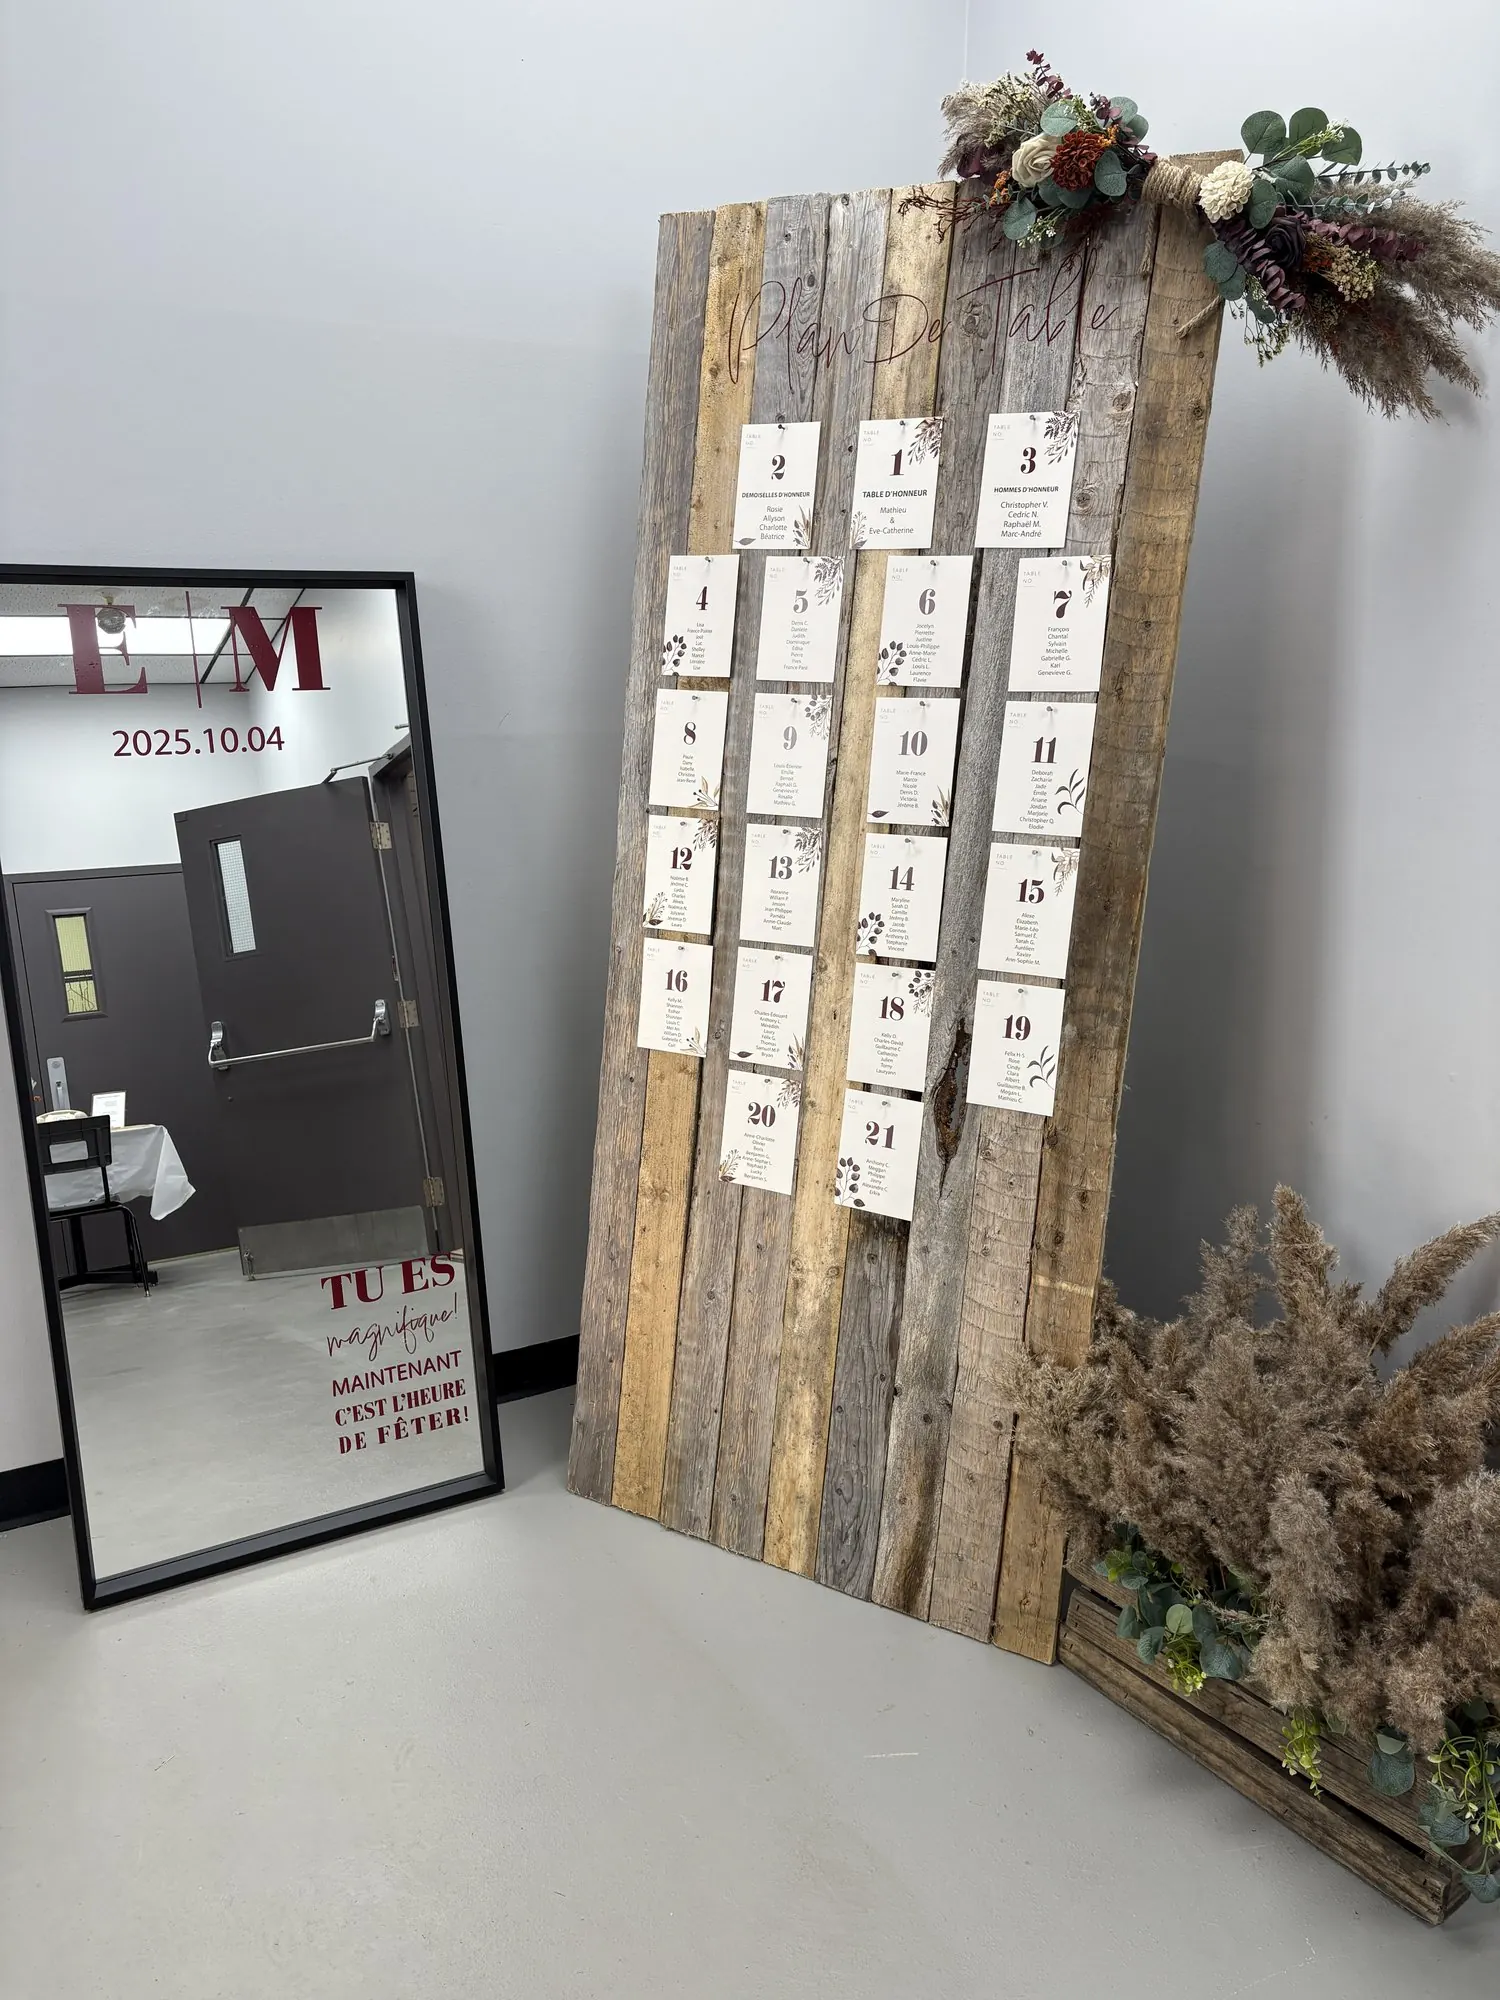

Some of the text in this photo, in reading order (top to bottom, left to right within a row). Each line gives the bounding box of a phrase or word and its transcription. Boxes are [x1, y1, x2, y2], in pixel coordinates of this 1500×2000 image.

[728, 249, 1119, 395] Plan De Table
[771, 454, 786, 480] 2
[889, 449, 904, 476] 1
[1020, 447, 1036, 474] 3
[884, 489, 928, 497] D'HONNEUR
[1000, 502, 1041, 510] Christopher
[762, 515, 786, 523] Allyson
[880, 506, 907, 514] Mathieu
[1003, 521, 1032, 529] Raphaël
[696, 586, 708, 611] 4
[793, 589, 808, 613] 5
[919, 588, 936, 615] 6
[1053, 590, 1072, 618] 7
[57, 603, 331, 695] E M
[112, 726, 285, 757] 2025.10.04
[683, 722, 696, 745] 8
[783, 726, 798, 750] 9
[899, 730, 928, 756] 10
[1031, 736, 1057, 764] 11
[671, 846, 693, 870] 12
[768, 855, 793, 880] 13
[889, 866, 915, 891] 14
[1016, 878, 1045, 904] 15
[665, 969, 688, 993] 16
[760, 979, 786, 1003] 17
[879, 995, 904, 1021] 18
[1002, 1014, 1031, 1041] 19
[747, 1101, 776, 1127] 20
[865, 1120, 896, 1151] 21
[321, 1252, 455, 1310] TU ES
[326, 1292, 458, 1361] magnifique!
[332, 1350, 462, 1397] MAINTENANT
[335, 1379, 466, 1426] C'EST L'HEURE
[339, 1406, 469, 1454] DE FÊTER!
